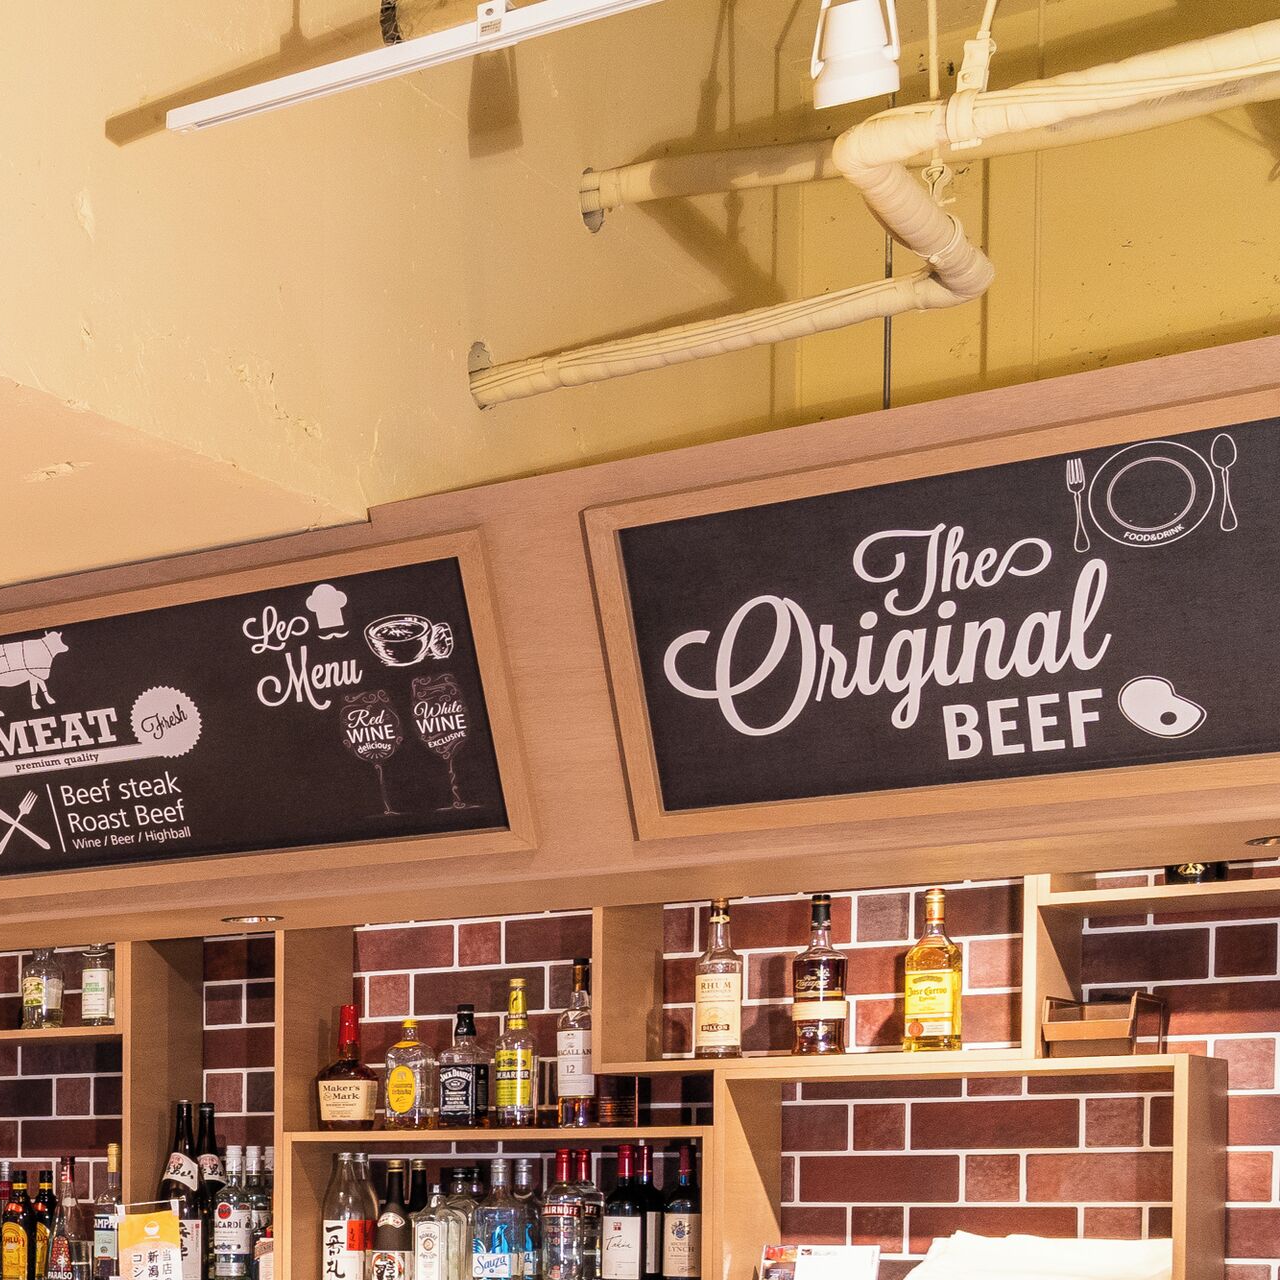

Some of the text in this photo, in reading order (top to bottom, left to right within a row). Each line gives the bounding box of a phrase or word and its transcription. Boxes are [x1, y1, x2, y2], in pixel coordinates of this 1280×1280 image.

[1123, 523, 1185, 542] FOOD&DRINK
[852, 522, 1052, 616] The
[242, 606, 309, 654] Le
[663, 558, 1112, 736] Original
[257, 645, 363, 710] Menu
[347, 709, 386, 730] Red
[413, 701, 463, 720] White
[141, 704, 187, 740] Fresh
[416, 714, 467, 734] WINE
[942, 688, 1102, 760] BEEF
[346, 724, 396, 744] WINE
[428, 731, 467, 749] EXCLUSIVE
[357, 742, 392, 754] delicious
[15, 753, 99, 773] premium quality
[60, 771, 182, 807] Beef steak
[67, 799, 185, 834] Roast Beef
[72, 837, 101, 850] Wine
[110, 834, 135, 846] Beer
[145, 826, 191, 843] Highball
[700, 981, 731, 990] RHUM
[566, 1065, 575, 1073] 12
[323, 1084, 360, 1092] Maker's
[474, 1255, 508, 1274] Sauza
